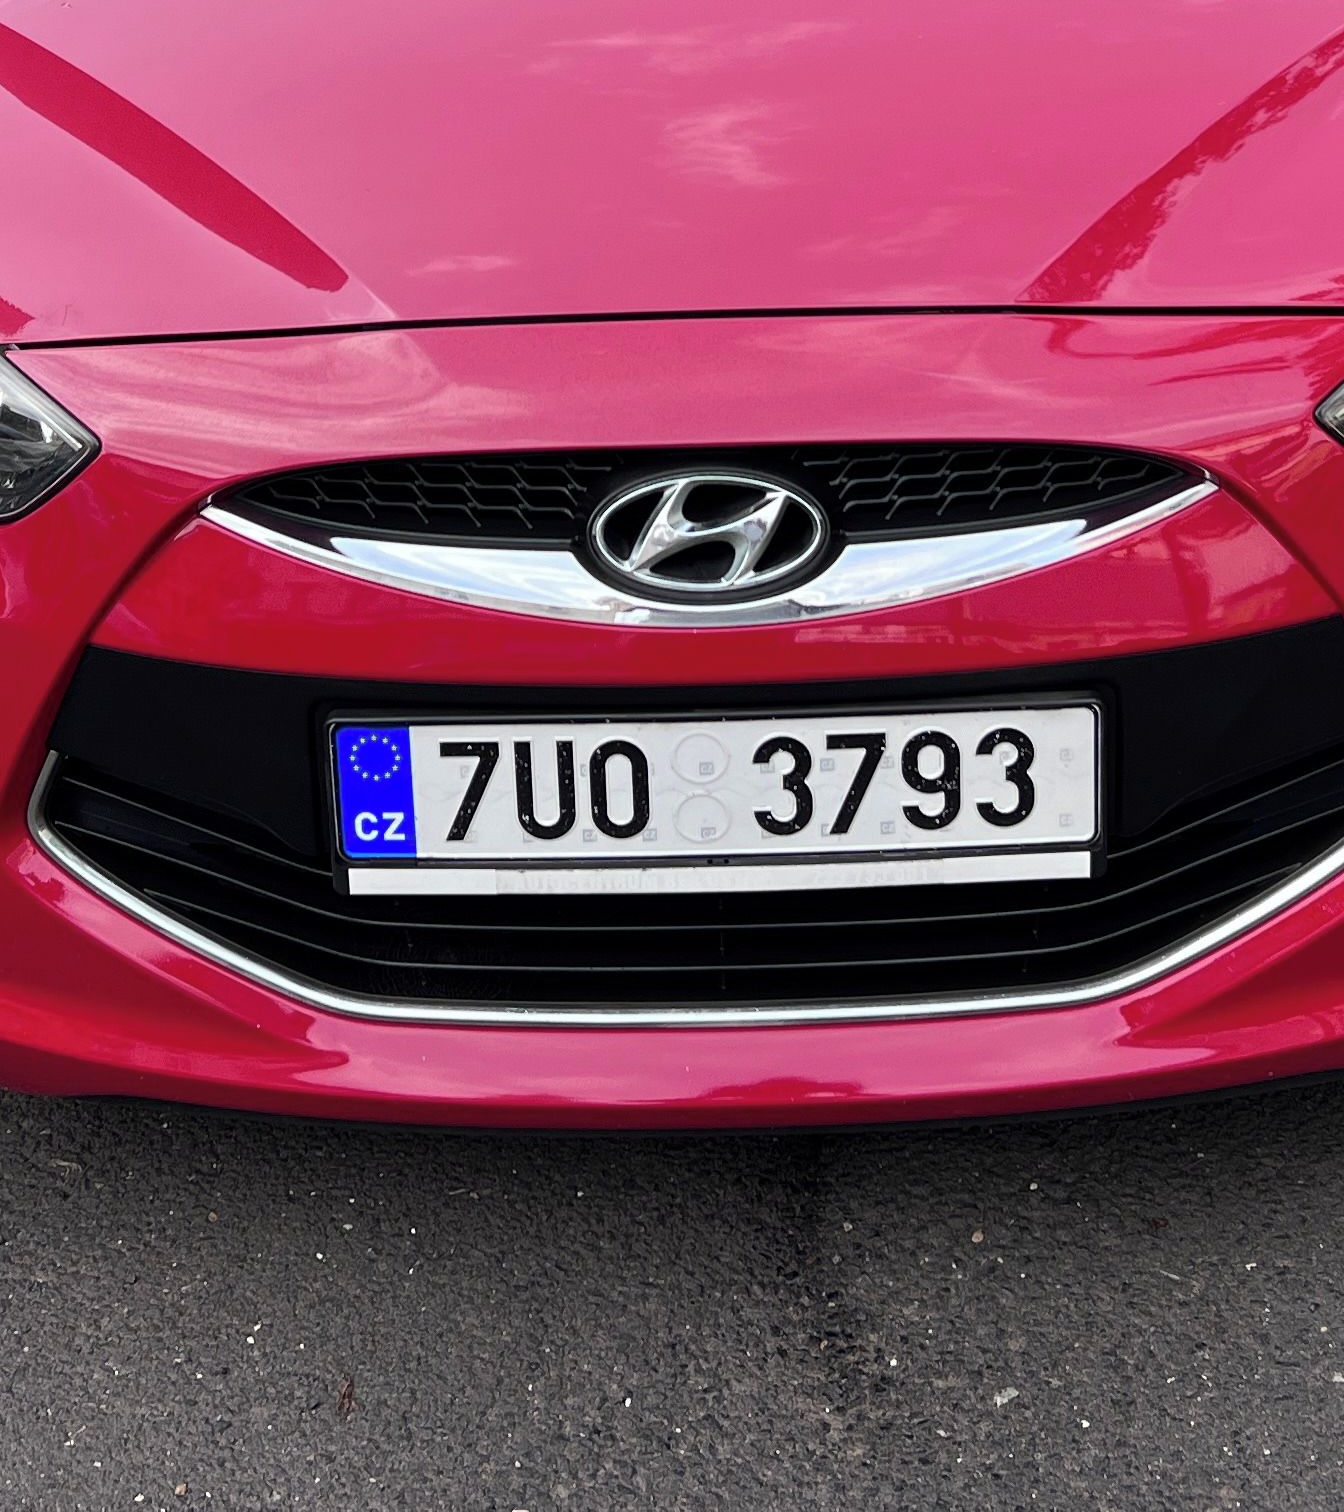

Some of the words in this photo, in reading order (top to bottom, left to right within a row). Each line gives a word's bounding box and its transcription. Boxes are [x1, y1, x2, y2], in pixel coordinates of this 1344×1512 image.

[354, 811, 406, 841] CZ
[439, 739, 649, 842] 7U0
[752, 727, 1036, 836] 3793
